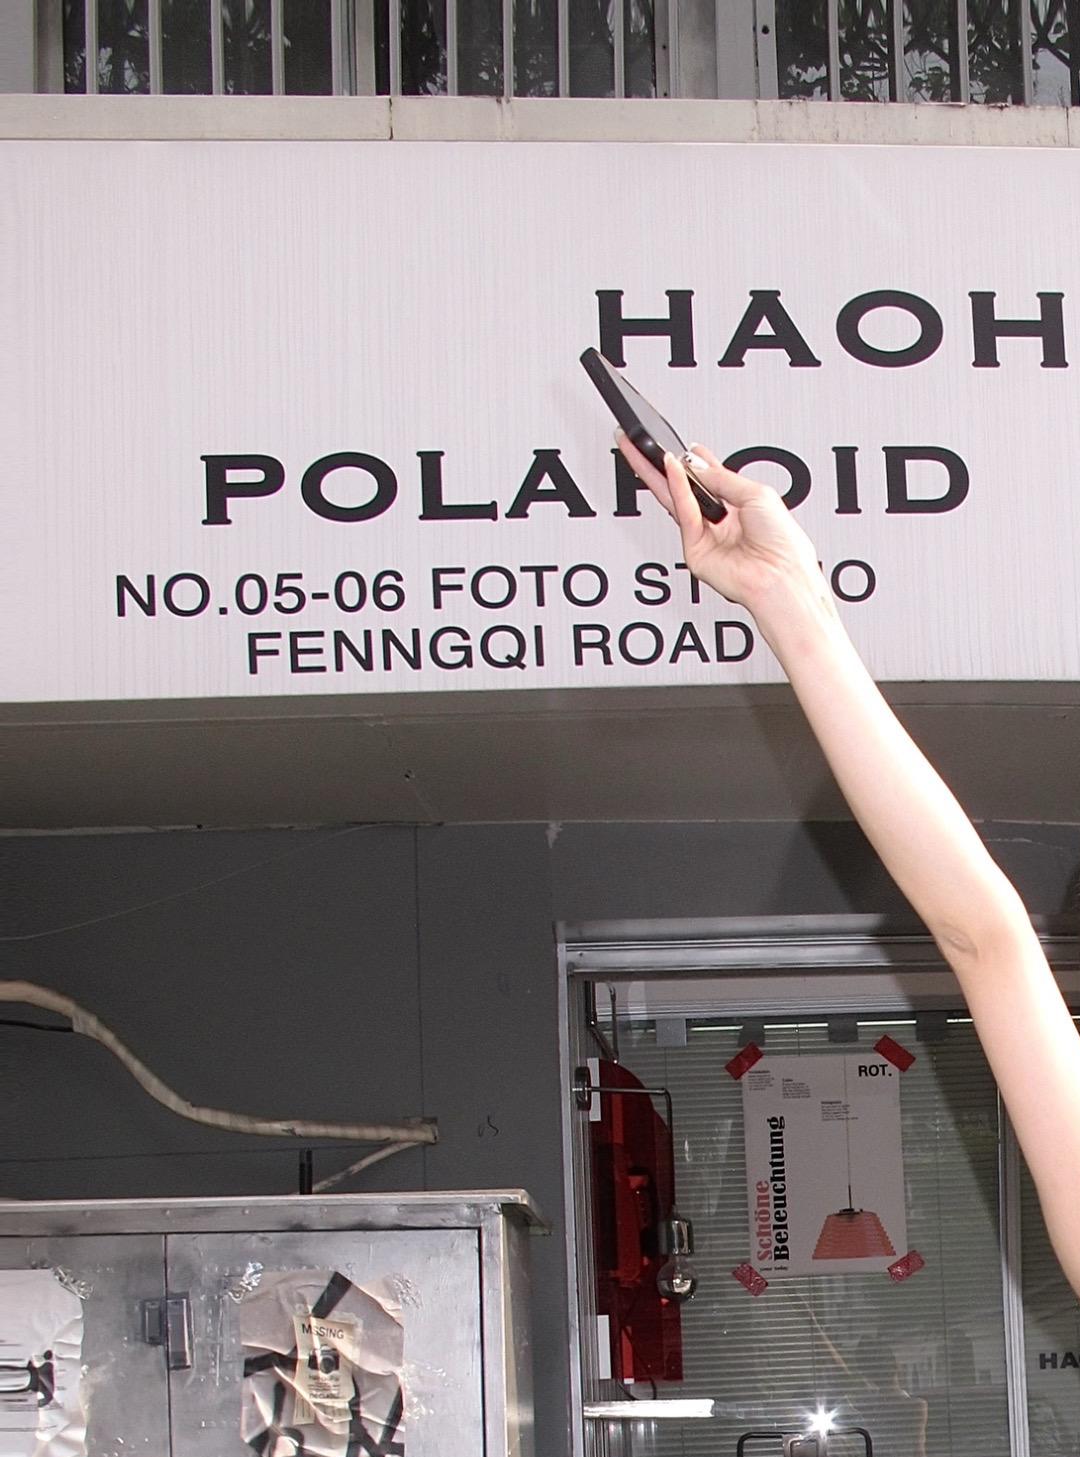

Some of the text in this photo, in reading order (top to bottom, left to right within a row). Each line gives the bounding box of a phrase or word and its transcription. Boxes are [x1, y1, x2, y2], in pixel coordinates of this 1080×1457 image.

[116, 559, 876, 618] NO.05-06 FOTO STO
[247, 620, 755, 675] FENNGQI ROAD
[858, 1064, 892, 1078] ROT.
[767, 1115, 790, 1262] Beleuchtung
[755, 1180, 773, 1262] Schöne
